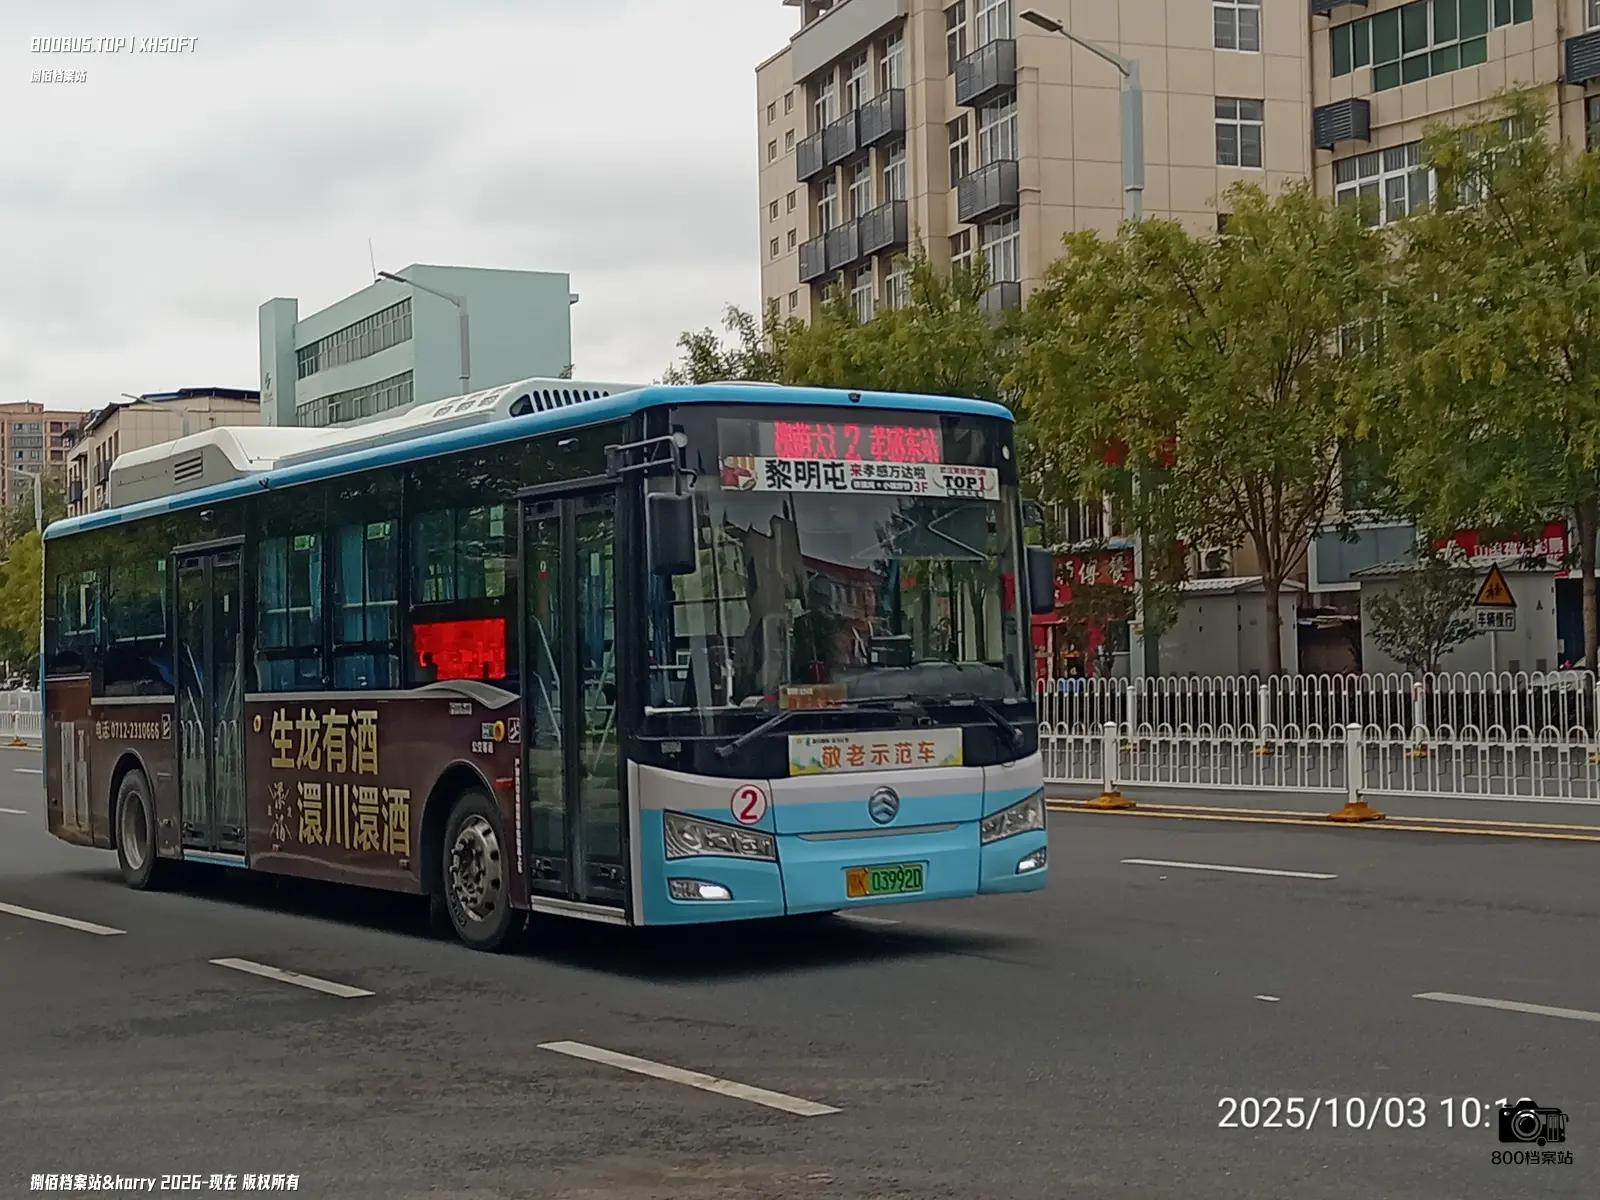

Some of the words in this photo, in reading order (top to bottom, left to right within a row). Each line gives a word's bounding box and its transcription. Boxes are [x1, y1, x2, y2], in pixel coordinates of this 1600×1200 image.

[843, 423, 862, 461] 2
[765, 459, 848, 490] 黎明屯
[850, 463, 926, 480] 来孝感万达啦
[943, 475, 986, 490] TOP1
[913, 481, 928, 493] 3F
[1477, 610, 1513, 628] 车辆慢行
[270, 707, 379, 776] 生龙有酒
[821, 741, 936, 769] 敬老示范车
[740, 789, 758, 820] 2
